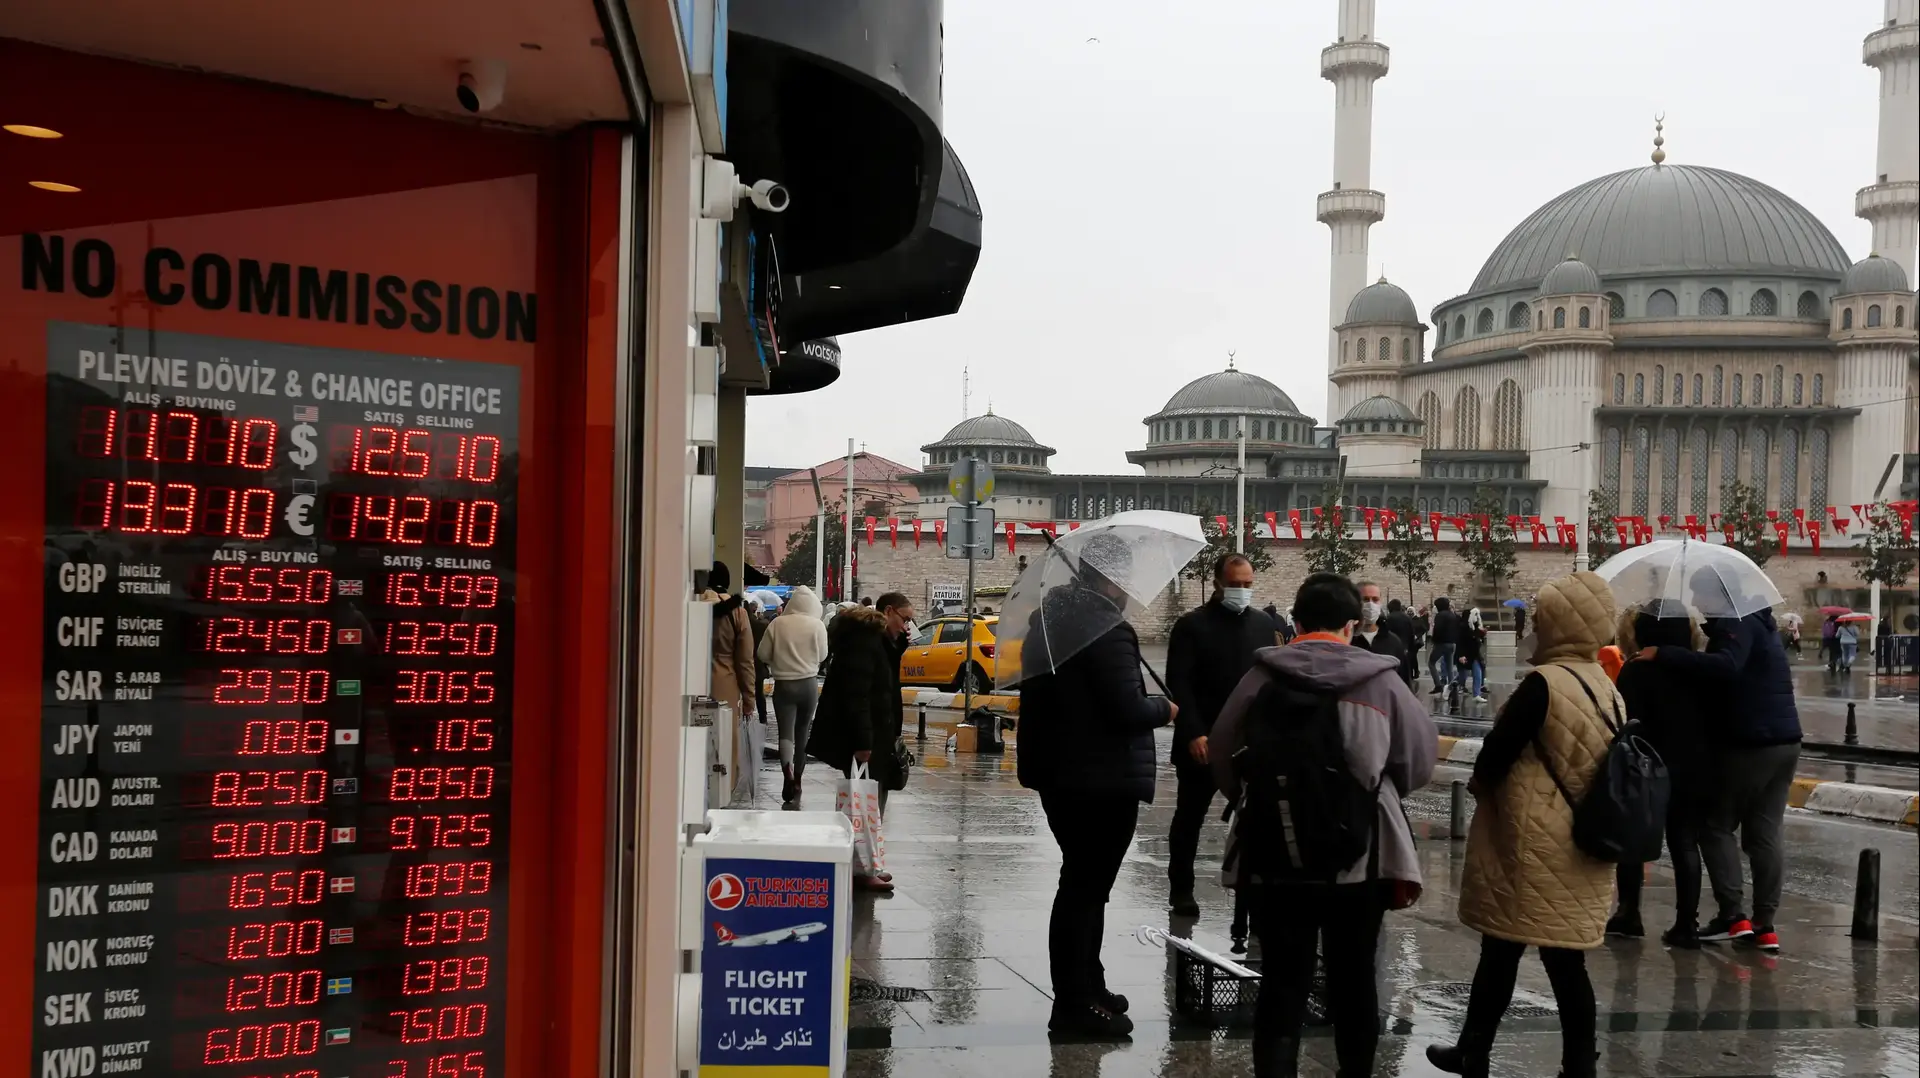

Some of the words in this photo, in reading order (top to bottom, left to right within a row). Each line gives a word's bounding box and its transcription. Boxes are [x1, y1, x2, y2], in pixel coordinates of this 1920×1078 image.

[21, 232, 116, 298] NO
[143, 247, 537, 343] COMMISSION
[79, 350, 188, 389] PLEVNE
[196, 357, 276, 396] DÖVİZ
[284, 369, 302, 398] &
[311, 372, 413, 407] CHANGE
[419, 382, 501, 414] OFFICE
[124, 391, 161, 408] ALIŞ
[175, 396, 236, 412] BUYING
[364, 410, 404, 426] SATIŞ
[416, 415, 474, 429] SELLING
[288, 422, 318, 470] $
[284, 494, 316, 535] €
[212, 550, 247, 564] ALIŞ
[261, 551, 318, 564] BUYING
[383, 555, 423, 570] SATIŞ
[434, 557, 492, 570] SELLING
[59, 562, 107, 593] GBP
[118, 562, 162, 578] İNGİLİZ
[118, 580, 171, 595] STERLİNİ
[57, 616, 104, 647] CHF
[117, 616, 163, 633] İSVİÇRE
[55, 669, 102, 700] SAR
[115, 671, 126, 683] S.
[129, 671, 161, 683] ARAB
[114, 686, 152, 700] RİYALİ
[53, 724, 99, 755] JPY
[113, 725, 152, 737] JAPON
[113, 739, 141, 753] YENİ
[112, 777, 161, 790] AVUSTR.
[51, 778, 100, 808] AUD
[111, 794, 154, 806] DOLARI
[110, 830, 158, 843] KANADA
[50, 831, 99, 863] CAD
[109, 846, 152, 860] DOLARI
[108, 880, 154, 896] DANİMR
[745, 877, 829, 893] TURKISH
[48, 885, 99, 917] DKK
[107, 899, 149, 913] KRONU
[745, 893, 829, 908] AIRLINES
[106, 934, 155, 950] NORVEÇ
[46, 939, 98, 972] NOK
[105, 952, 148, 967] KRONU
[725, 970, 807, 988] FLIGHT
[104, 988, 140, 1003] İSVEÇ
[44, 992, 92, 1026] SEK
[104, 1005, 146, 1020] KRONU
[727, 997, 804, 1015] TICKET
[718, 1028, 767, 1051] طيران
[773, 1027, 812, 1051] تذاكر
[102, 1040, 150, 1057] KUVEYT
[42, 1046, 96, 1078] KWD
[102, 1058, 142, 1074] DİNARI
